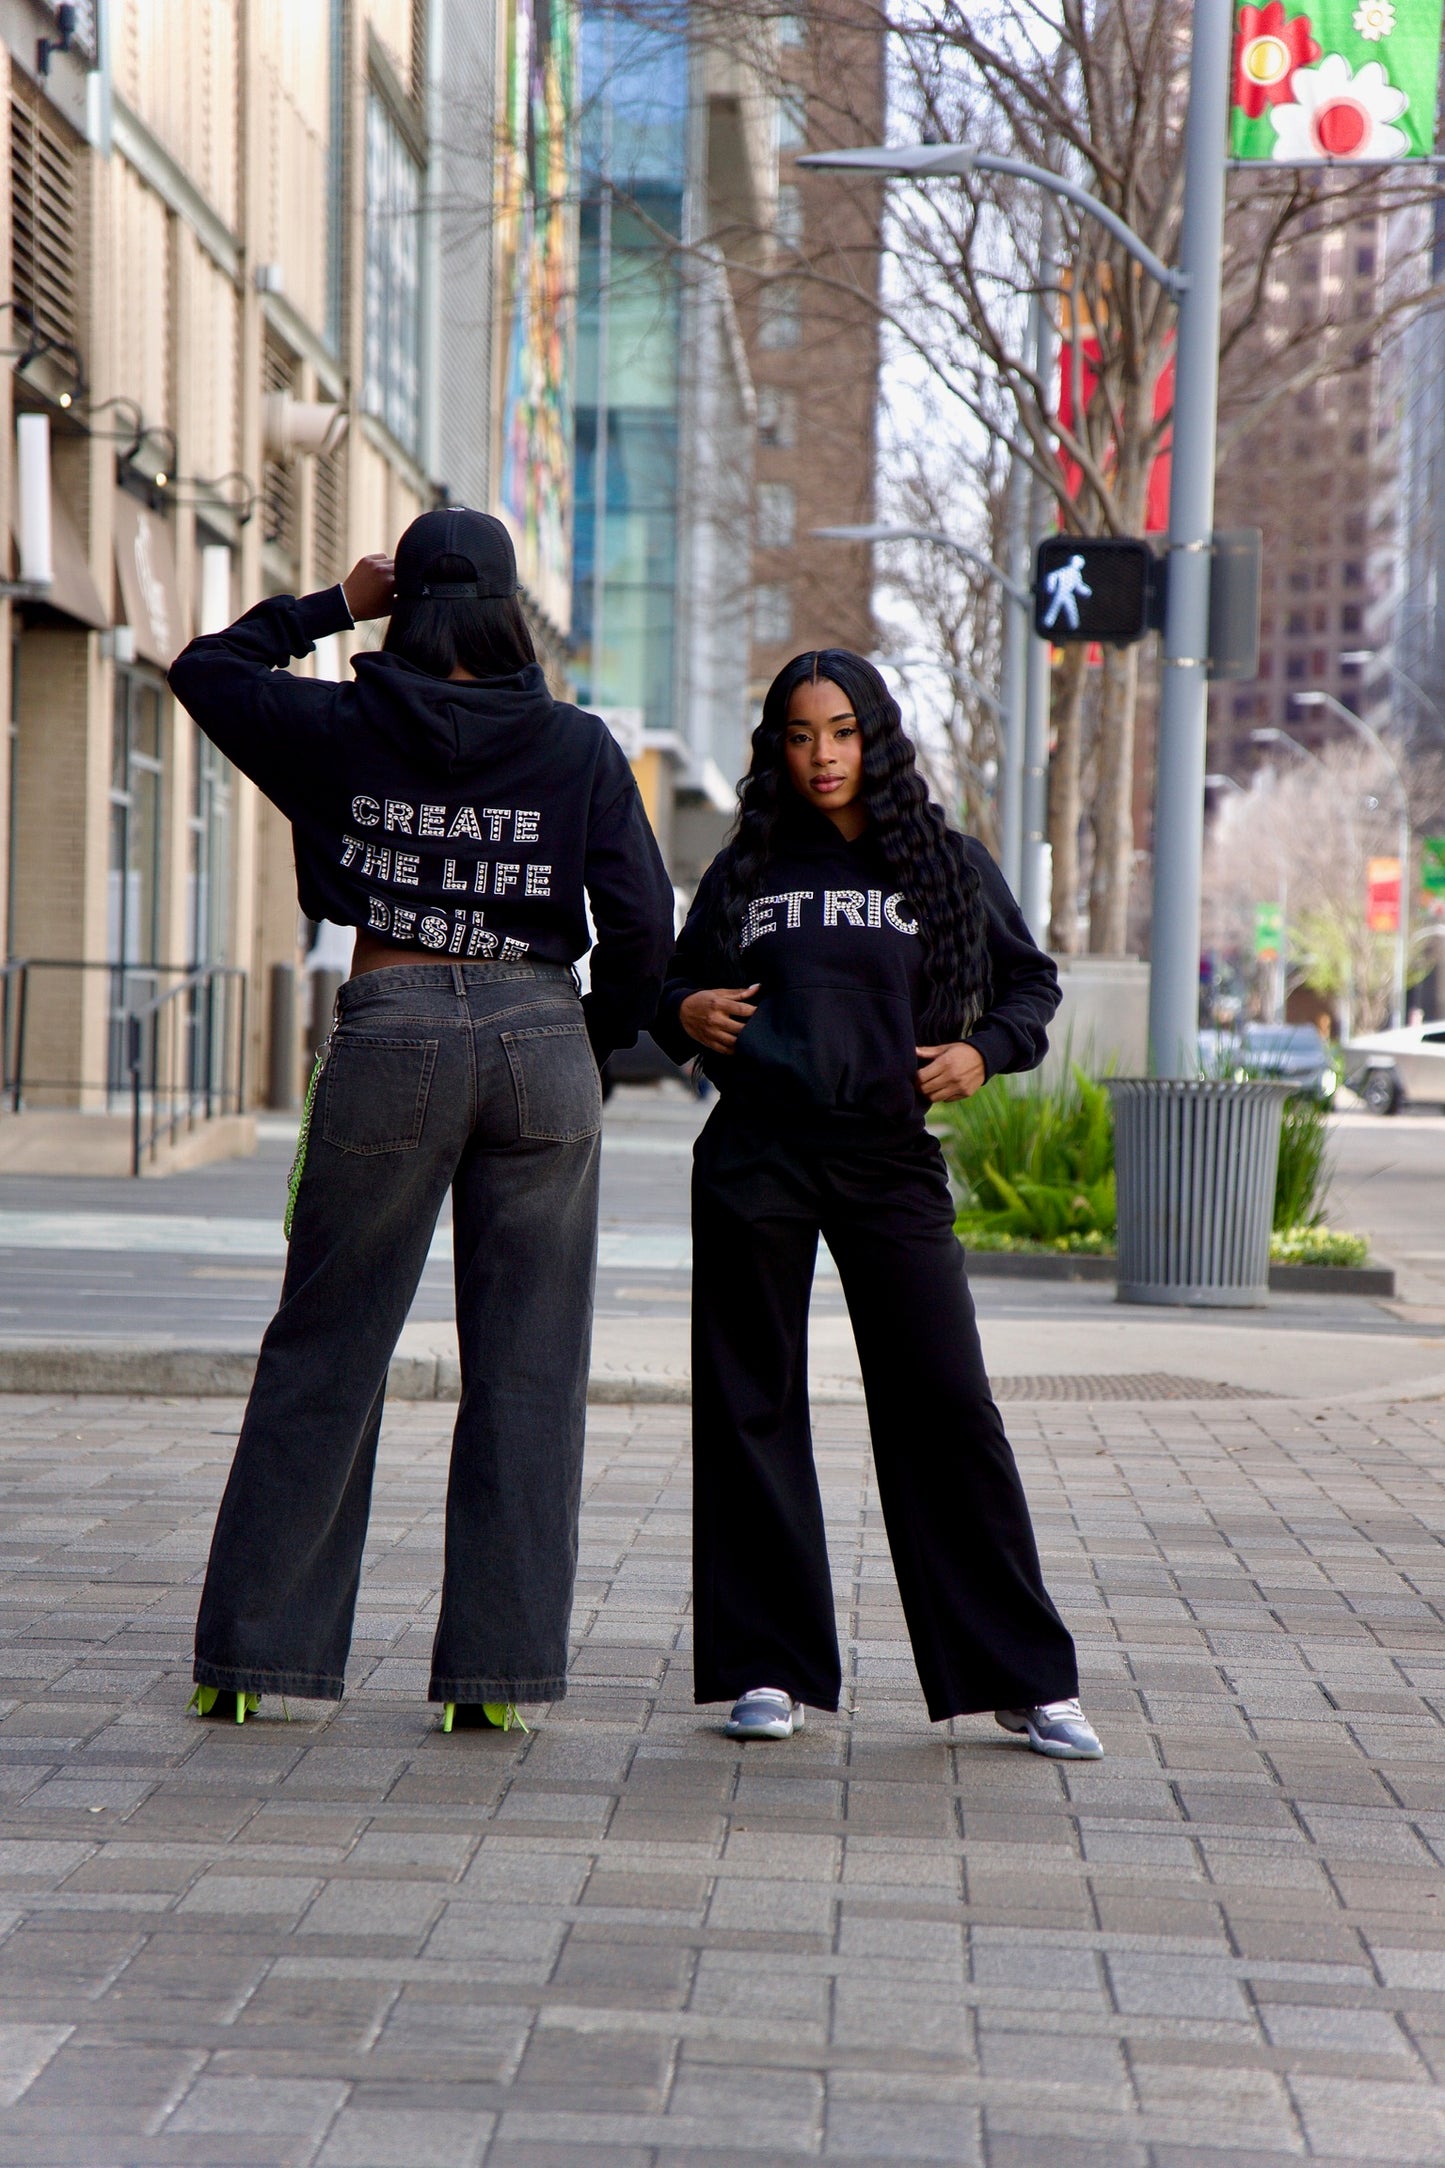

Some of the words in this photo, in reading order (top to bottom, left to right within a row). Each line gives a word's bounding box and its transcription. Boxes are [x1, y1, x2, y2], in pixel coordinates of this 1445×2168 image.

[352, 795, 541, 843] CREATE
[340, 834, 420, 886] THE
[442, 858, 552, 897] LIFE
[368, 896, 530, 961] DESIRE
[739, 891, 814, 952] ET
